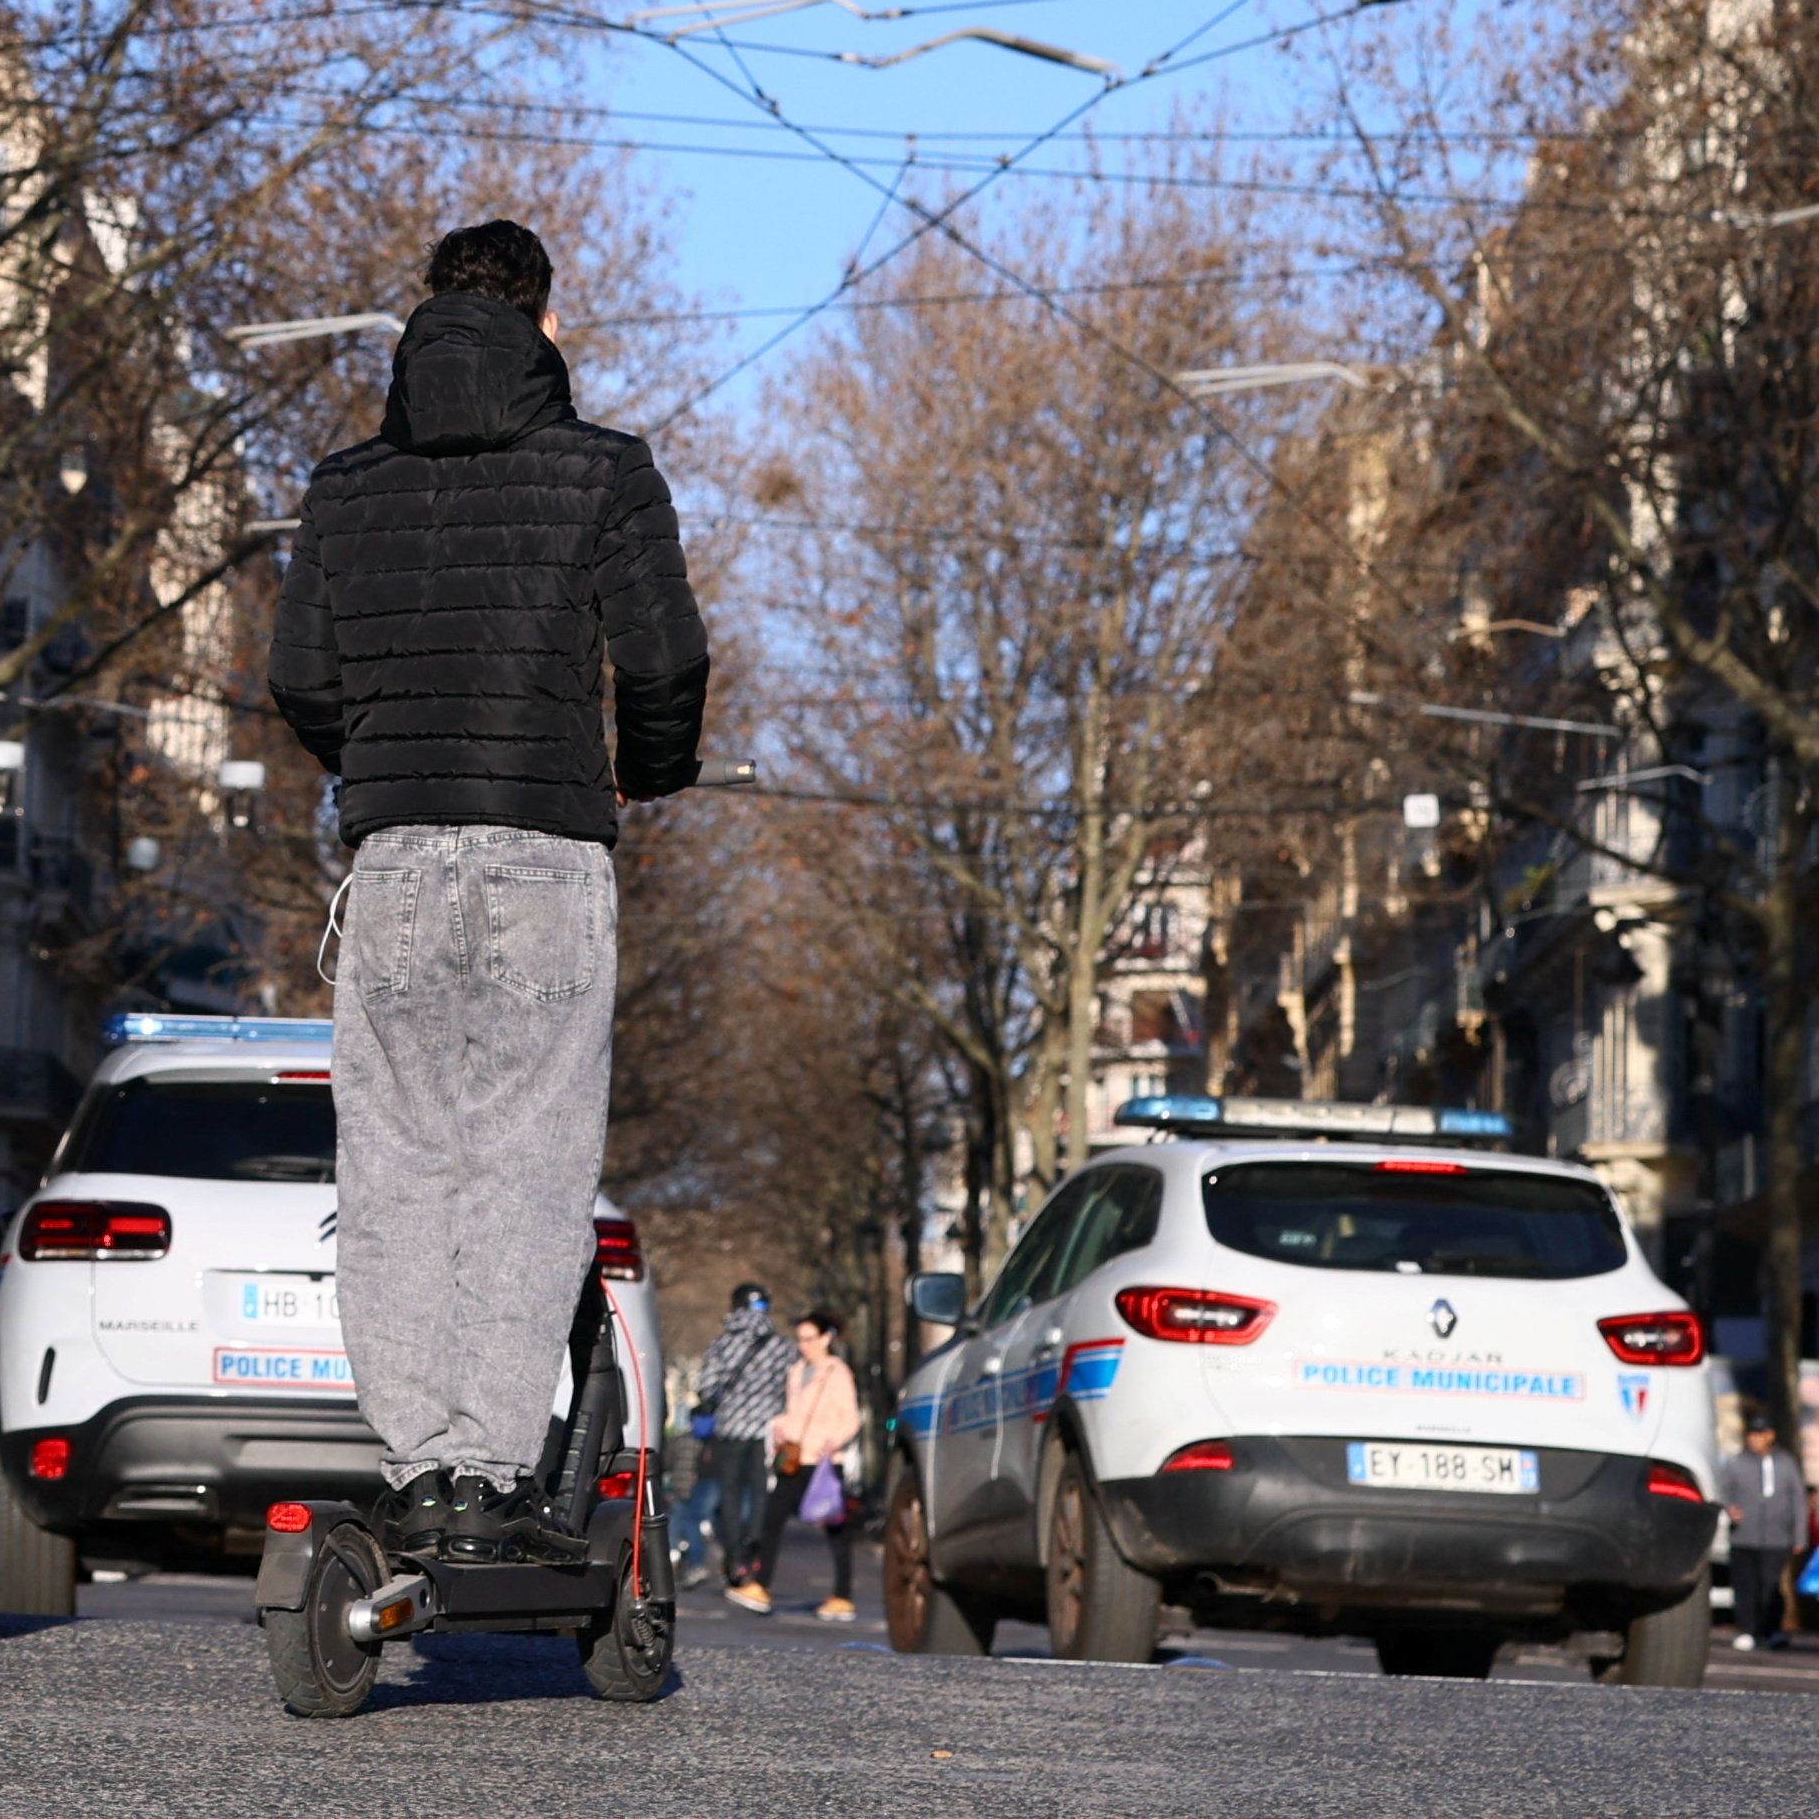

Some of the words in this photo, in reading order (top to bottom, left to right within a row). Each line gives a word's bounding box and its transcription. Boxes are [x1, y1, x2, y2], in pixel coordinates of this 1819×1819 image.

[220, 1354, 302, 1379] POLICE
[1382, 1349, 1504, 1364] KADJAR
[1302, 1363, 1400, 1388] POLICE
[1411, 1369, 1577, 1397] MUNICIPALE
